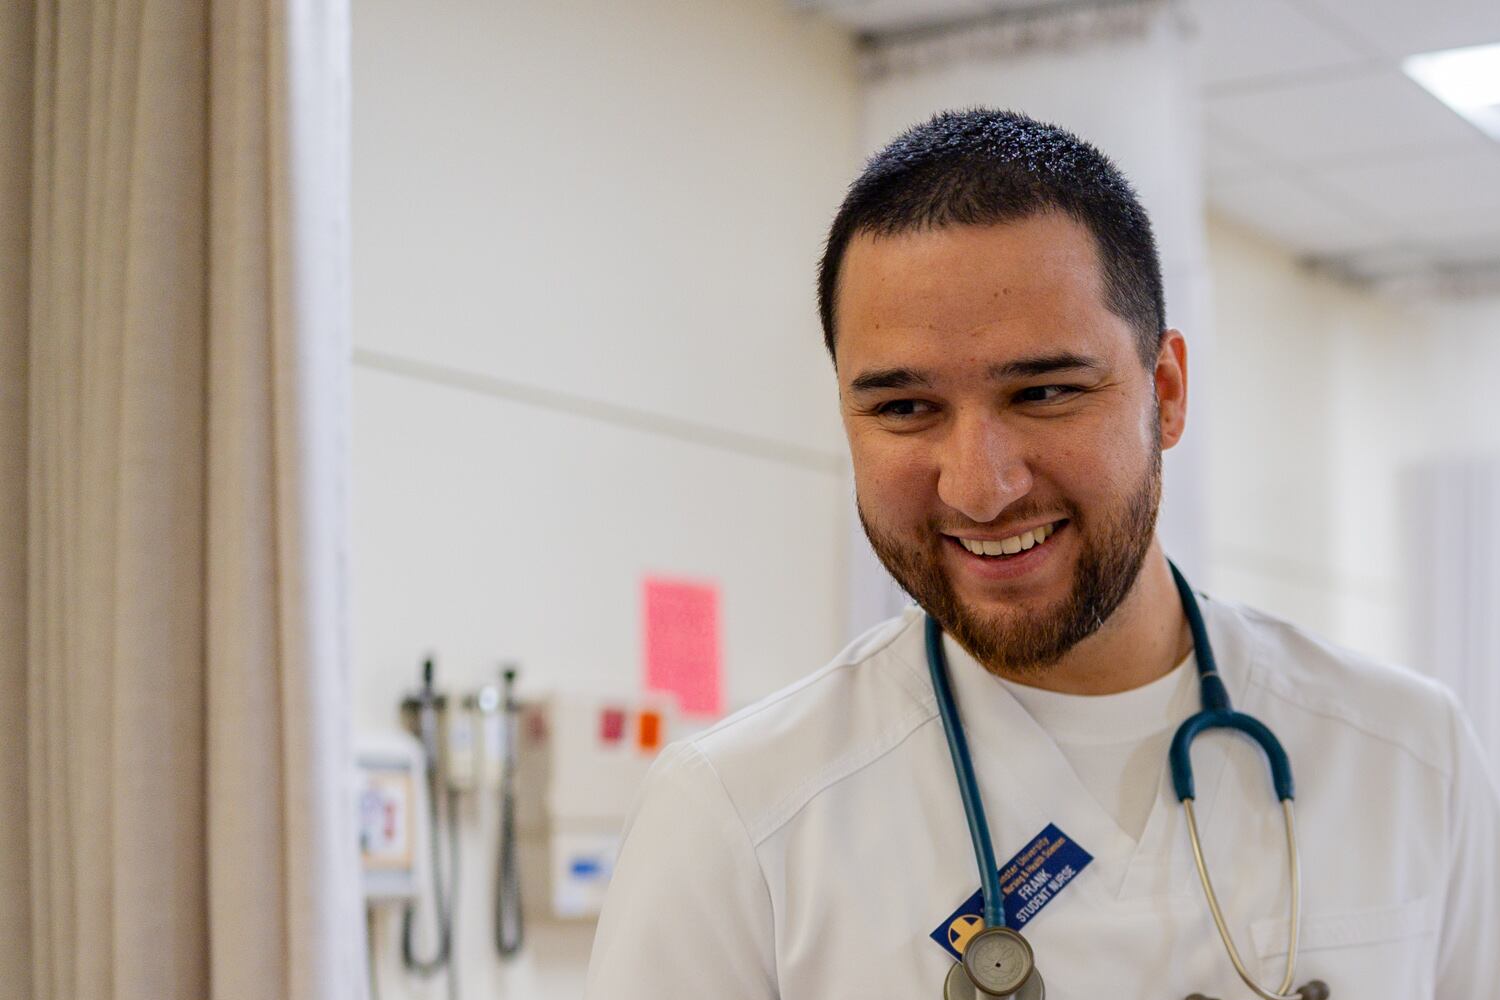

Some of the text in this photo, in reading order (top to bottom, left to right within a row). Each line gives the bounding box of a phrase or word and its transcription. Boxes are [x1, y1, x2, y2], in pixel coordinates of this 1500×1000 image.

[1002, 874, 1026, 895] Nursing
[1025, 856, 1045, 875] Health
[1041, 837, 1066, 859] Sciences
[1017, 837, 1049, 866] University
[1016, 864, 1077, 922] STUDENT NURSE
[1018, 868, 1052, 900] FRANK
